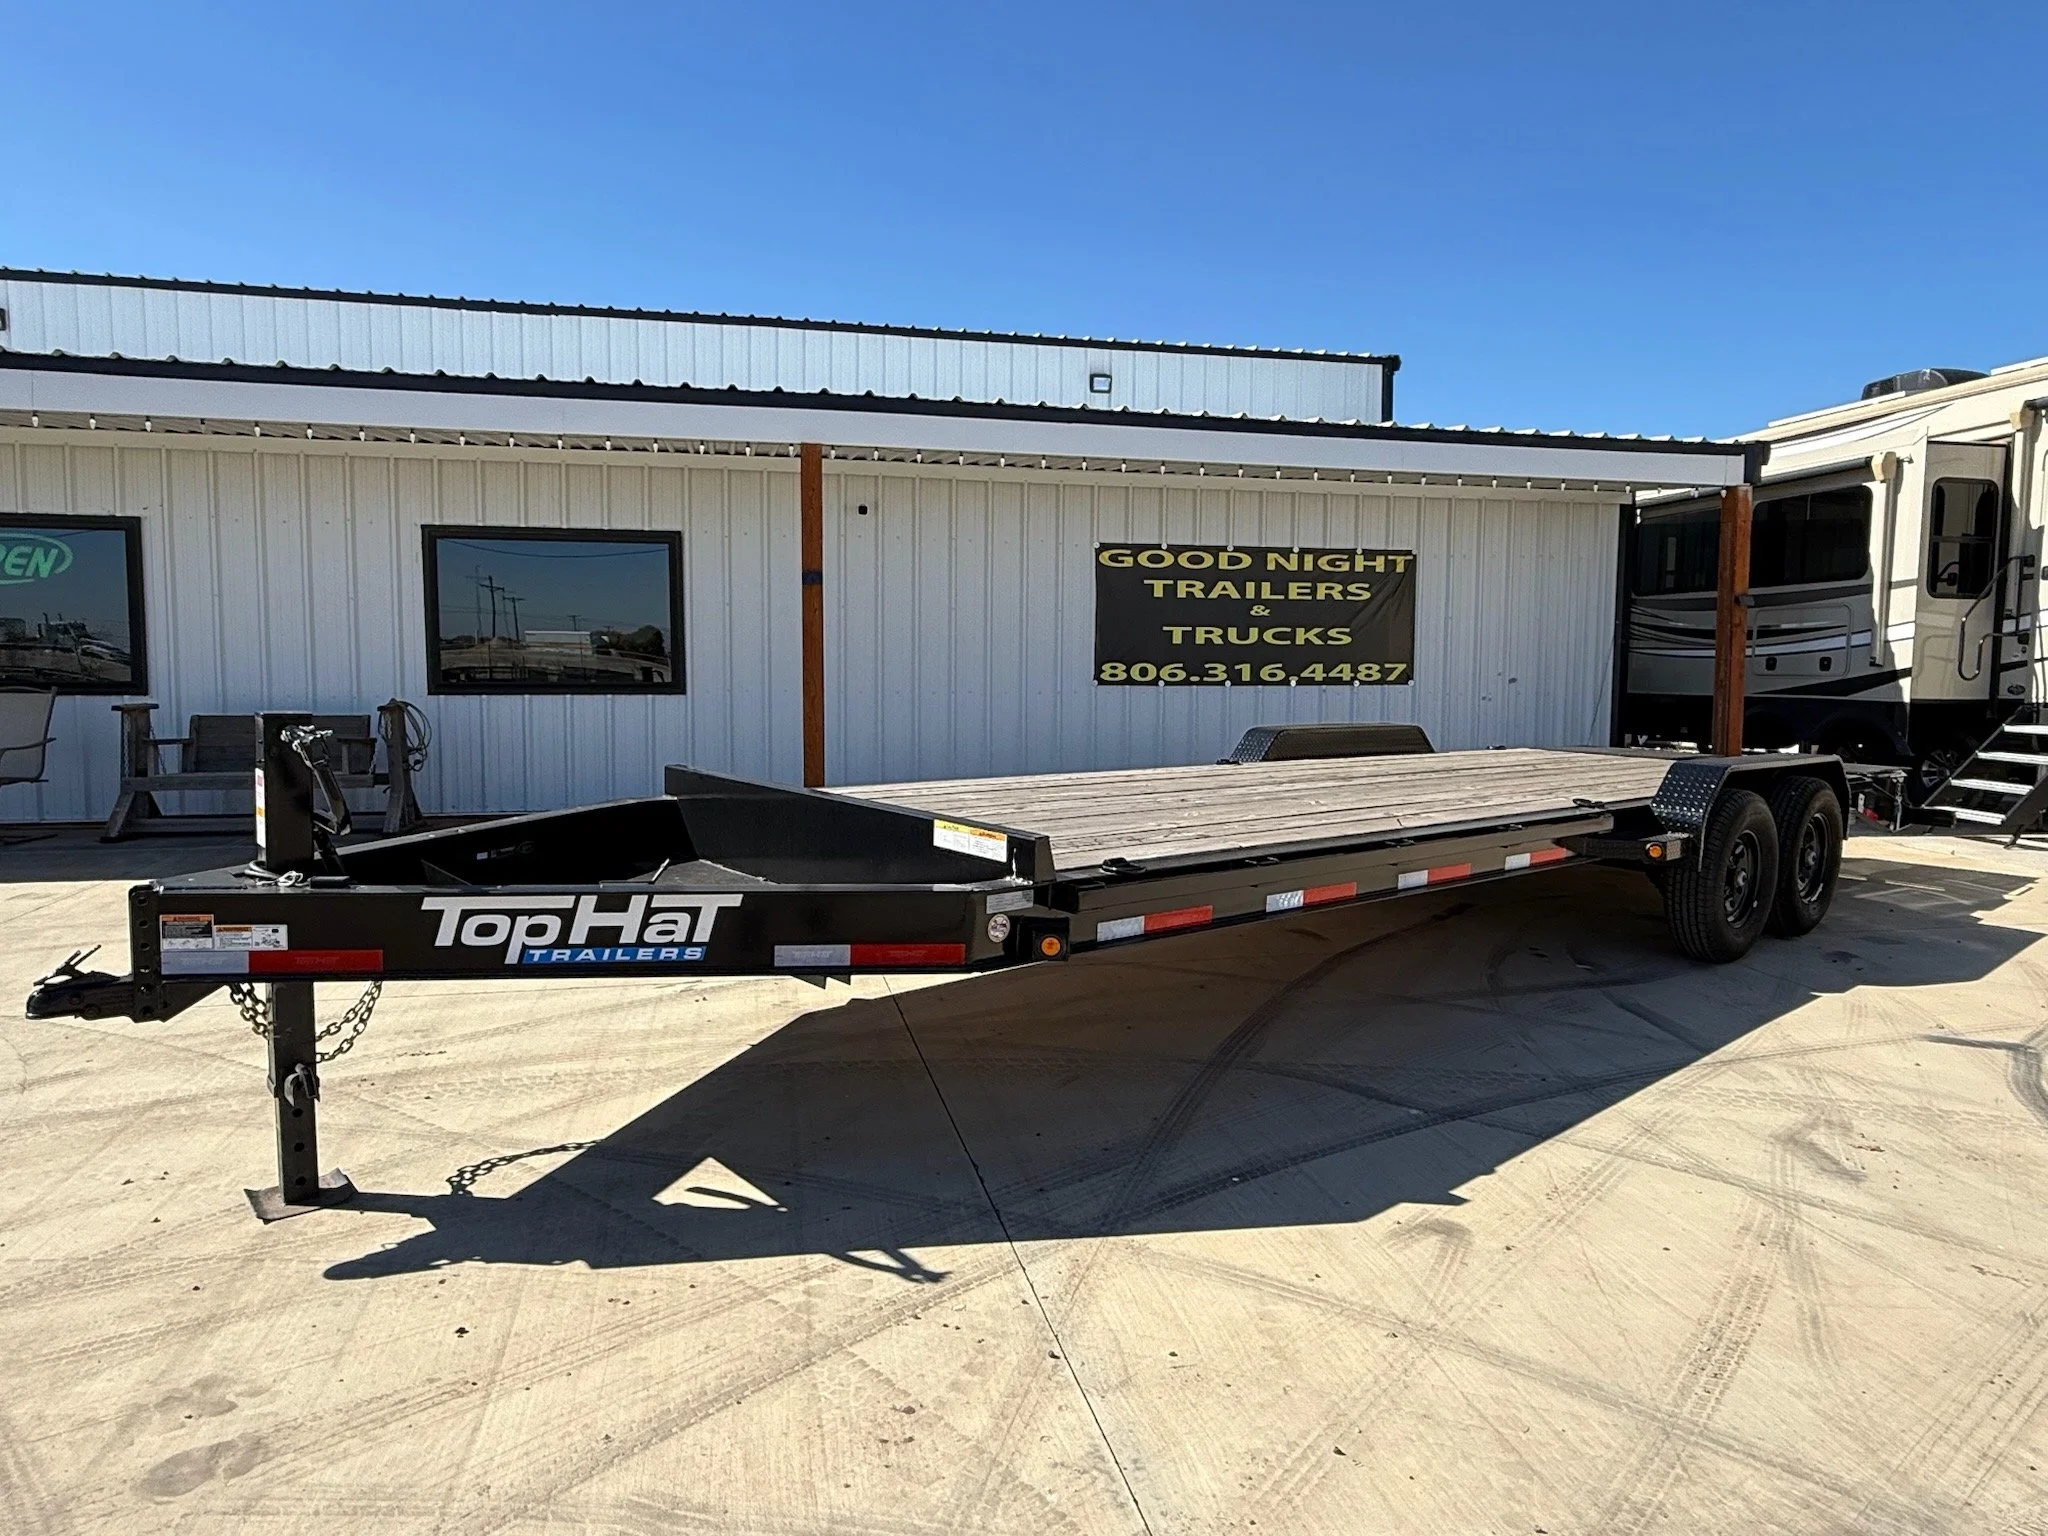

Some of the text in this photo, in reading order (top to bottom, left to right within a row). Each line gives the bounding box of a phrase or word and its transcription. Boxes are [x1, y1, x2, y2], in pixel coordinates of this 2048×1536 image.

[0, 544, 59, 578] EN
[1098, 549, 1414, 573] GOOD NIGHT
[1143, 579, 1372, 601] TRAILERS
[1249, 604, 1271, 617] &
[1162, 626, 1353, 646] TRUCKS
[1099, 662, 1408, 682] 806.316.4487
[527, 947, 703, 963] TRAILERS
